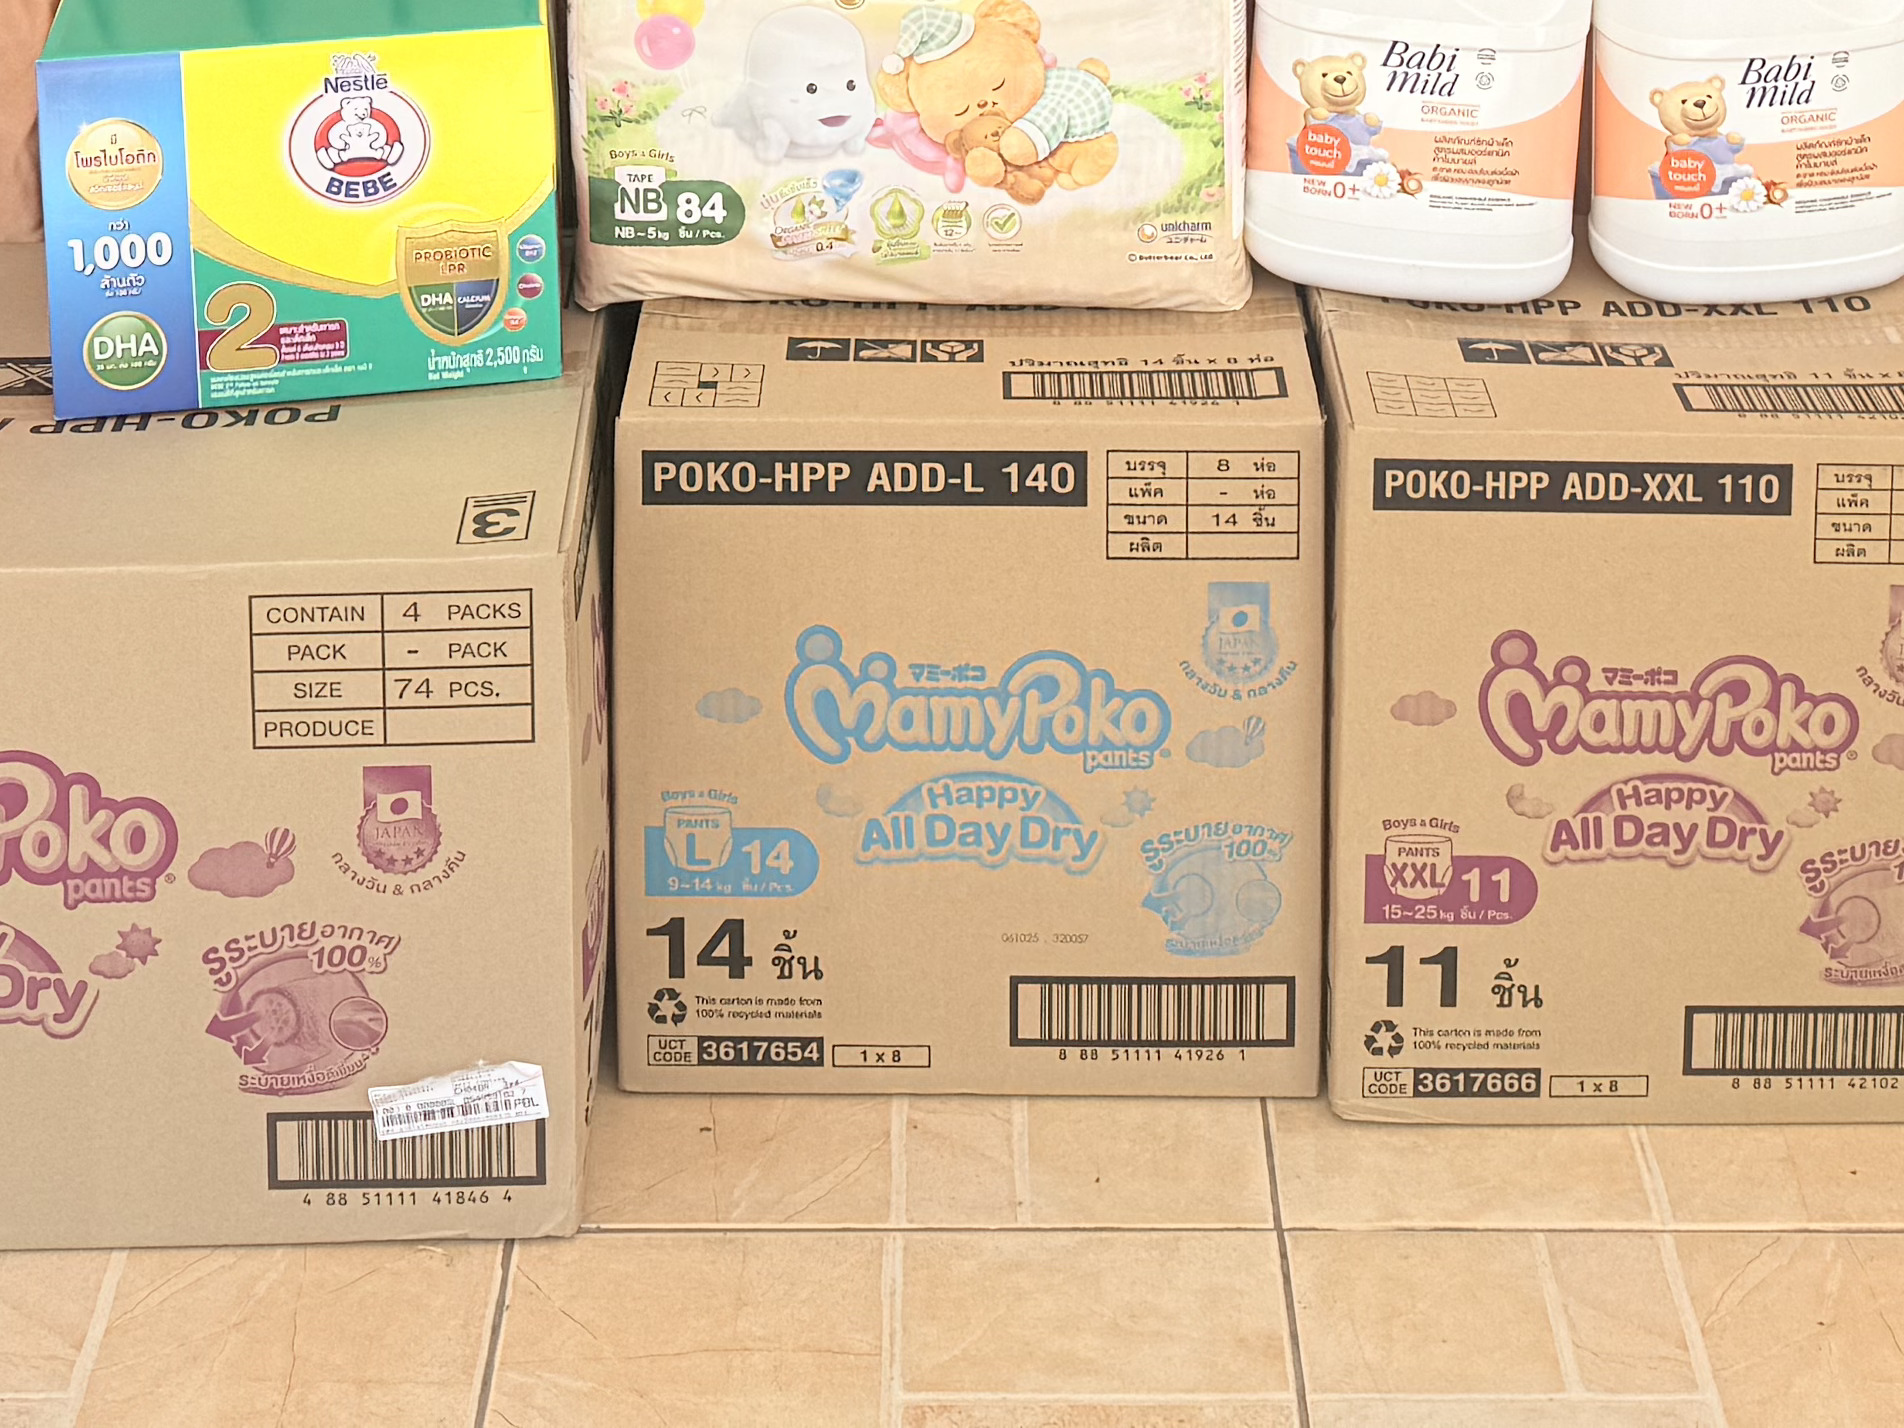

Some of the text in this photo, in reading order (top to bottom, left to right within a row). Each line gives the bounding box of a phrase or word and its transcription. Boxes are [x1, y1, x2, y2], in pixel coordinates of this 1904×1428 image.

[1380, 40, 1460, 73] Babi
[1738, 55, 1815, 86] Babi
[1421, 105, 1479, 119] ORGANIC
[1781, 111, 1837, 125] ORGANIC
[1304, 145, 1342, 159] touch
[326, 172, 398, 198] BEBE
[627, 173, 653, 183] TAPE
[1668, 170, 1706, 182] touch
[619, 187, 727, 224] NB 84
[67, 232, 173, 276] 1,000
[414, 247, 492, 265] PROBIOTIC
[440, 262, 467, 276] LPR
[205, 281, 280, 372] 2
[93, 333, 160, 360] DHA
[653, 461, 1076, 494] POKO-HPP ADD-L 140
[1383, 469, 1781, 504] POKO-HPP ADD-XXL 110
[265, 601, 522, 624] CONTAIN 4 PACKS
[286, 640, 508, 662] PACK PACK
[790, 653, 1167, 761] MamyPoko
[1483, 657, 1856, 764] MamyPoko
[263, 718, 375, 738] PRODUCE
[926, 781, 1042, 812] Happy
[1616, 781, 1729, 812] Happy
[646, 917, 824, 981] 14 ชิ้น
[1365, 945, 1544, 1009] 11 ชิ้น
[702, 1040, 820, 1062] 3617654
[1418, 1070, 1537, 1094] 3617666
